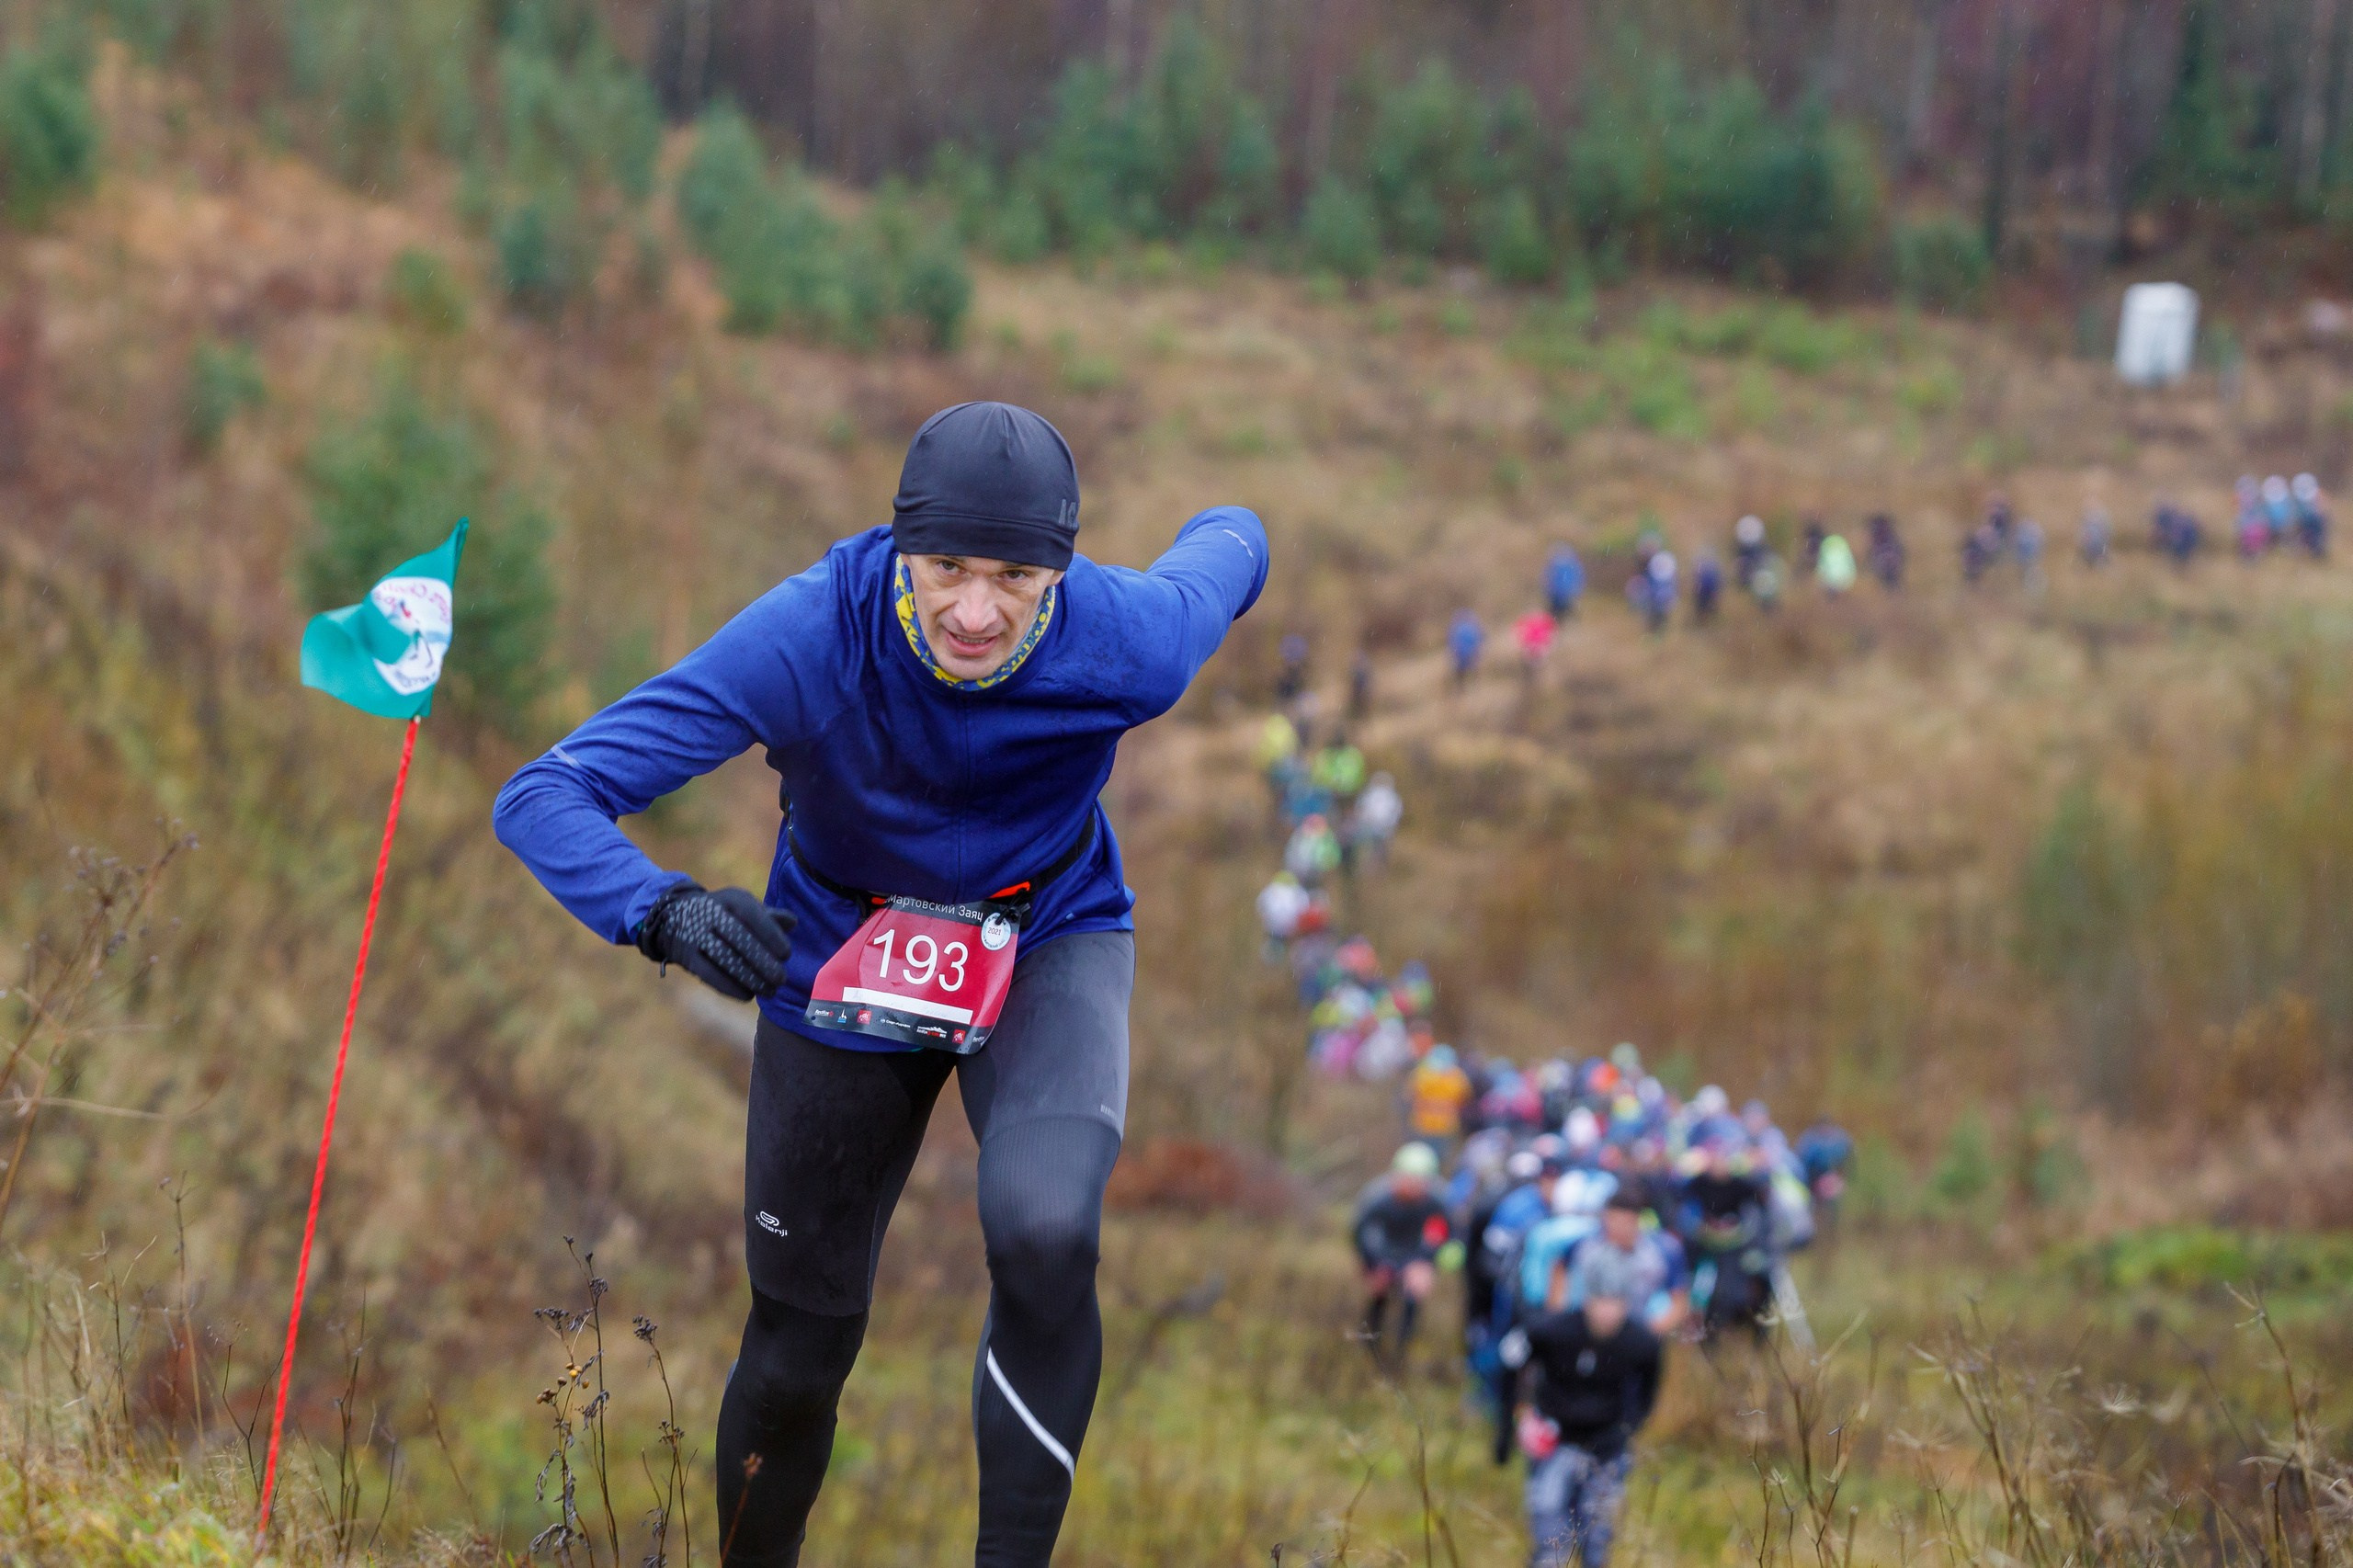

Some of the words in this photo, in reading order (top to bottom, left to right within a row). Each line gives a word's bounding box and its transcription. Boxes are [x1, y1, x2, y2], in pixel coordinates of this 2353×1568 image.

[886, 894, 955, 915] Мартовский
[958, 905, 983, 922] Заяц
[987, 926, 1001, 936] 2021
[873, 929, 969, 992] 193
